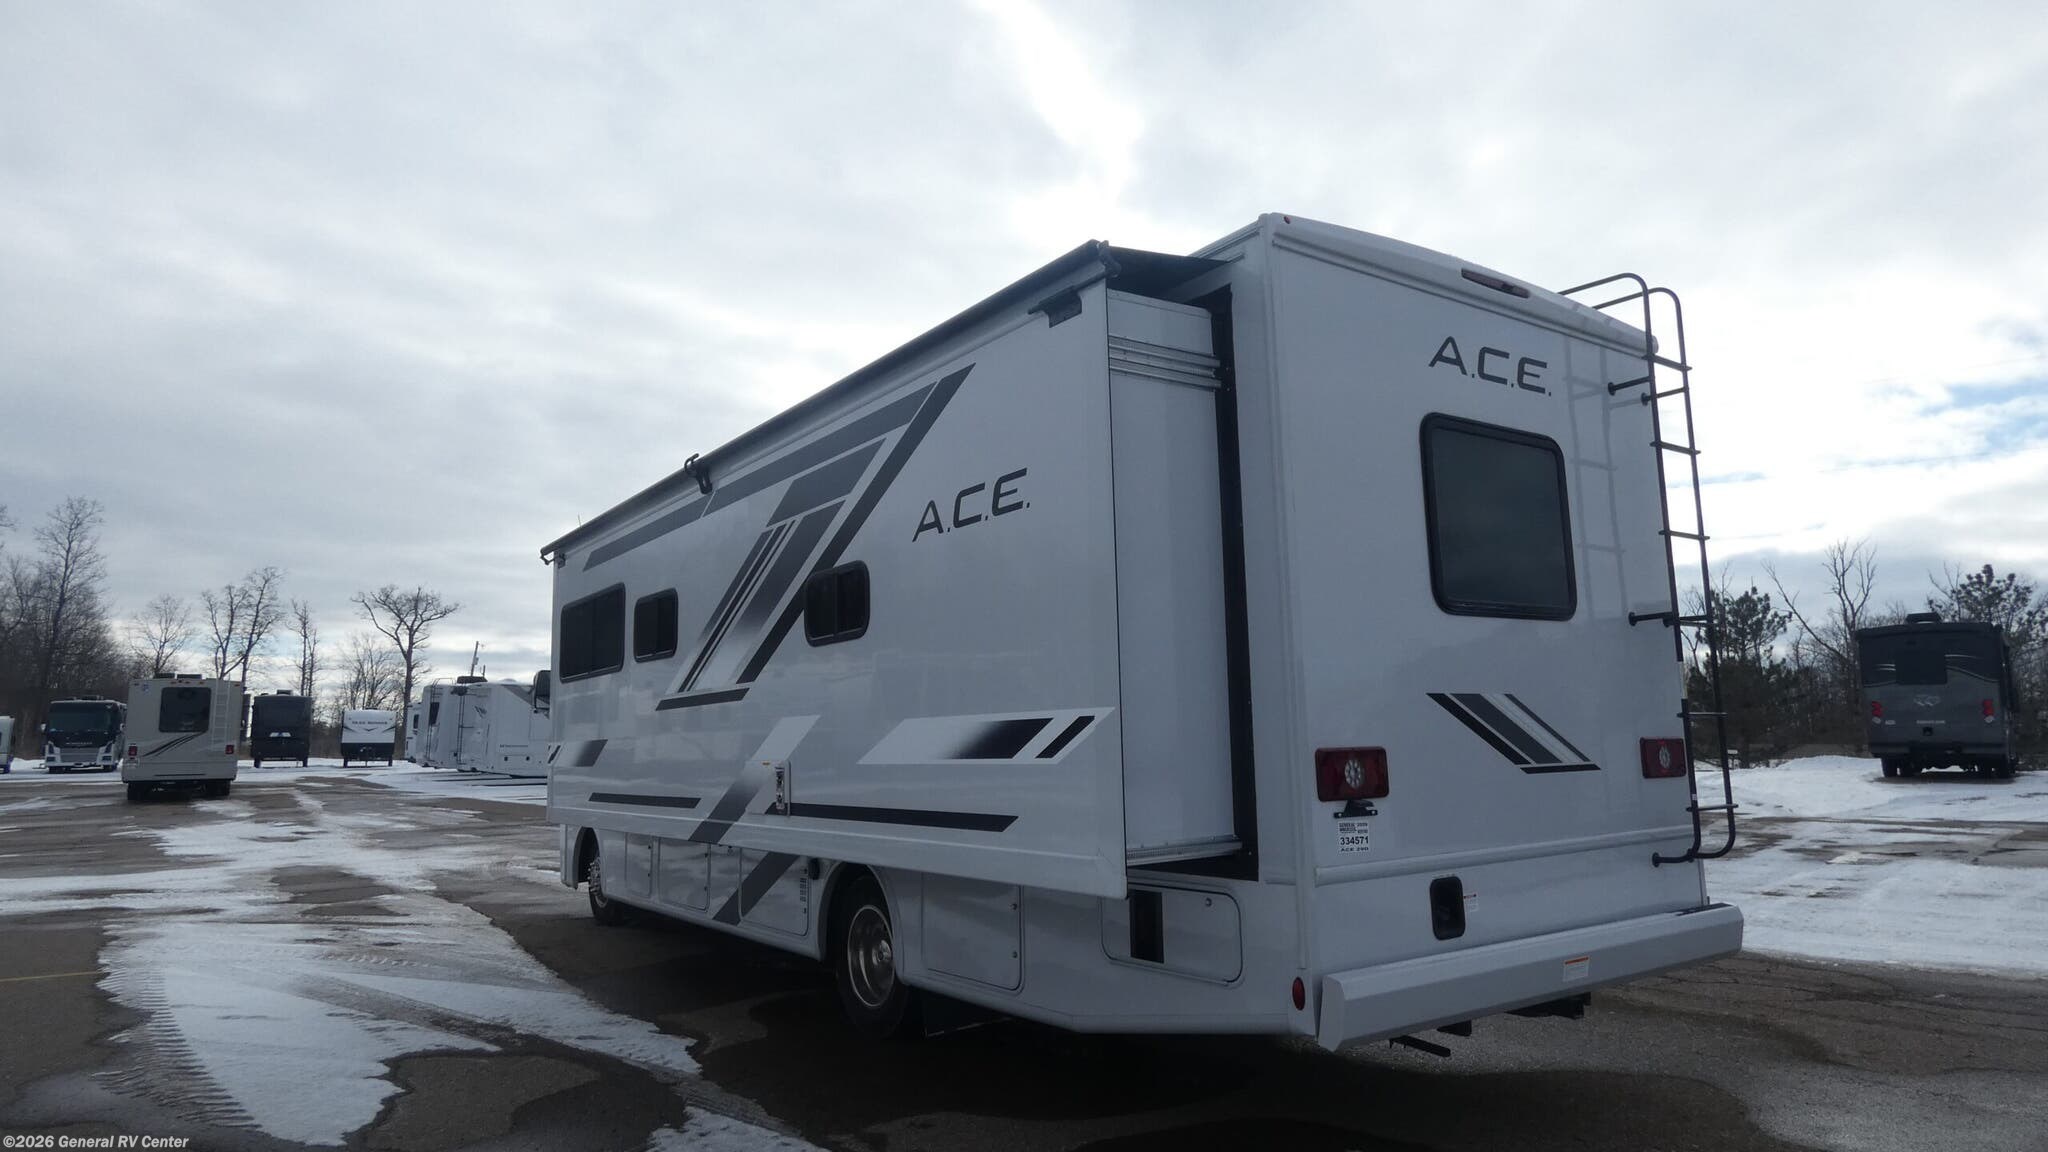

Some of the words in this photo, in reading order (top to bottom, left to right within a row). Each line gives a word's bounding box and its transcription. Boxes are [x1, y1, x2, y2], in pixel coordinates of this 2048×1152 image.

[1428, 335, 1551, 397] A.C.E.
[911, 467, 1031, 542] A.C.E.
[1340, 836, 1369, 846] 334571
